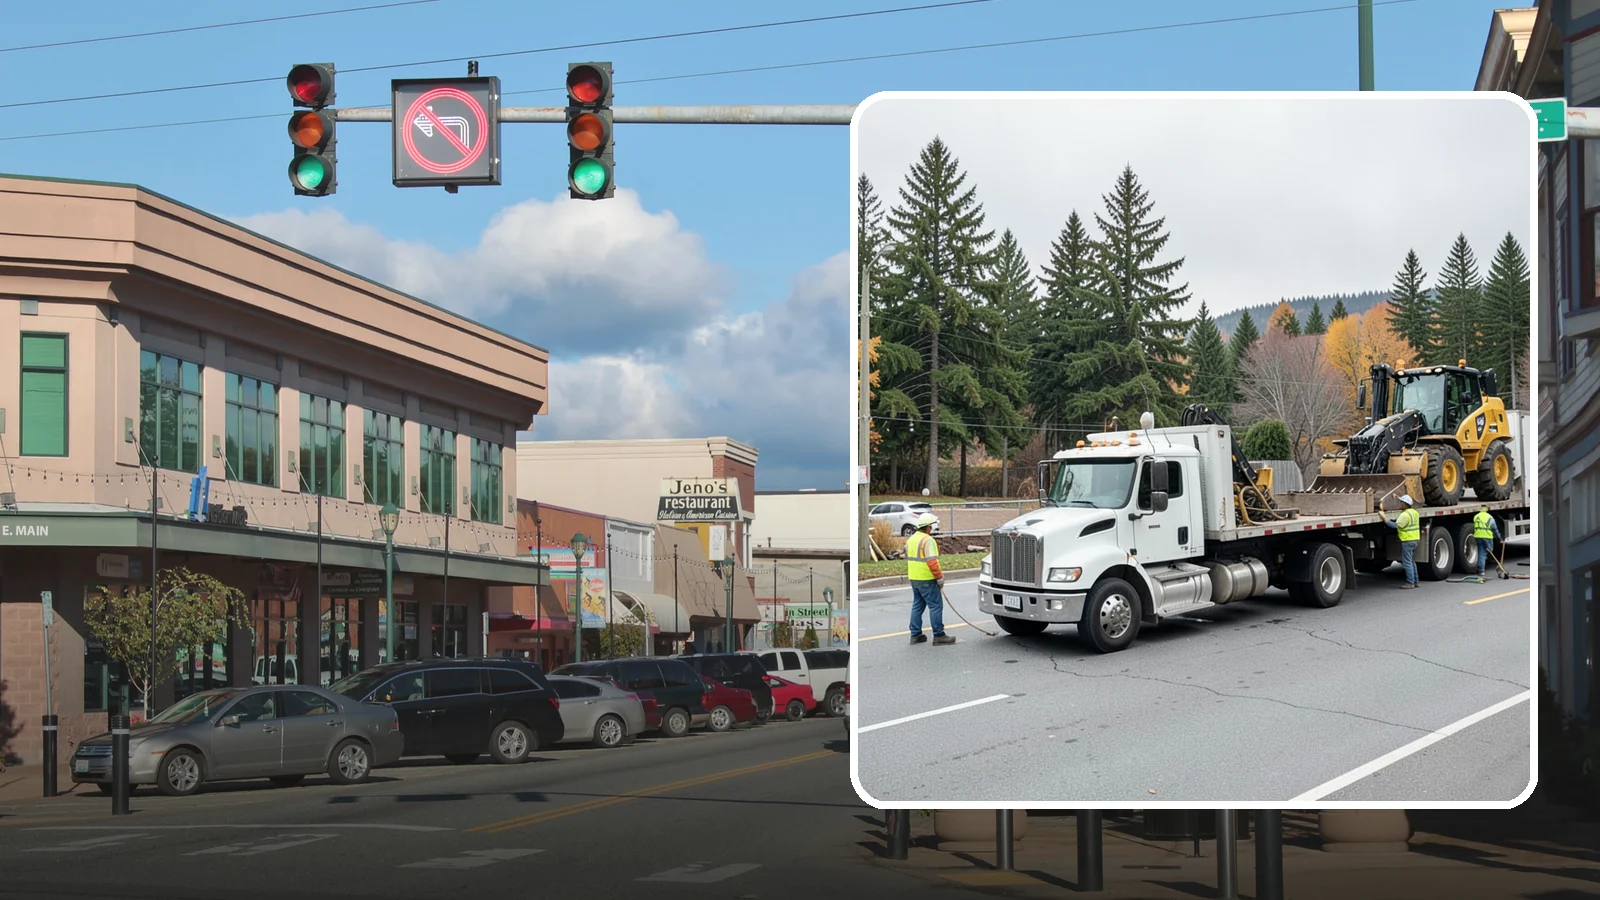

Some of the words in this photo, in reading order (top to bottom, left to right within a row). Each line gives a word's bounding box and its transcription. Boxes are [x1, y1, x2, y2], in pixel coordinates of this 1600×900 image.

[670, 480, 727, 495] Jeno's
[665, 496, 731, 509] restaurant
[658, 510, 681, 519] Italian
[686, 510, 714, 519] American
[715, 509, 738, 519] Cuisine
[2, 525, 13, 536] E.
[15, 525, 49, 536] MAIN
[797, 607, 829, 617] Street
